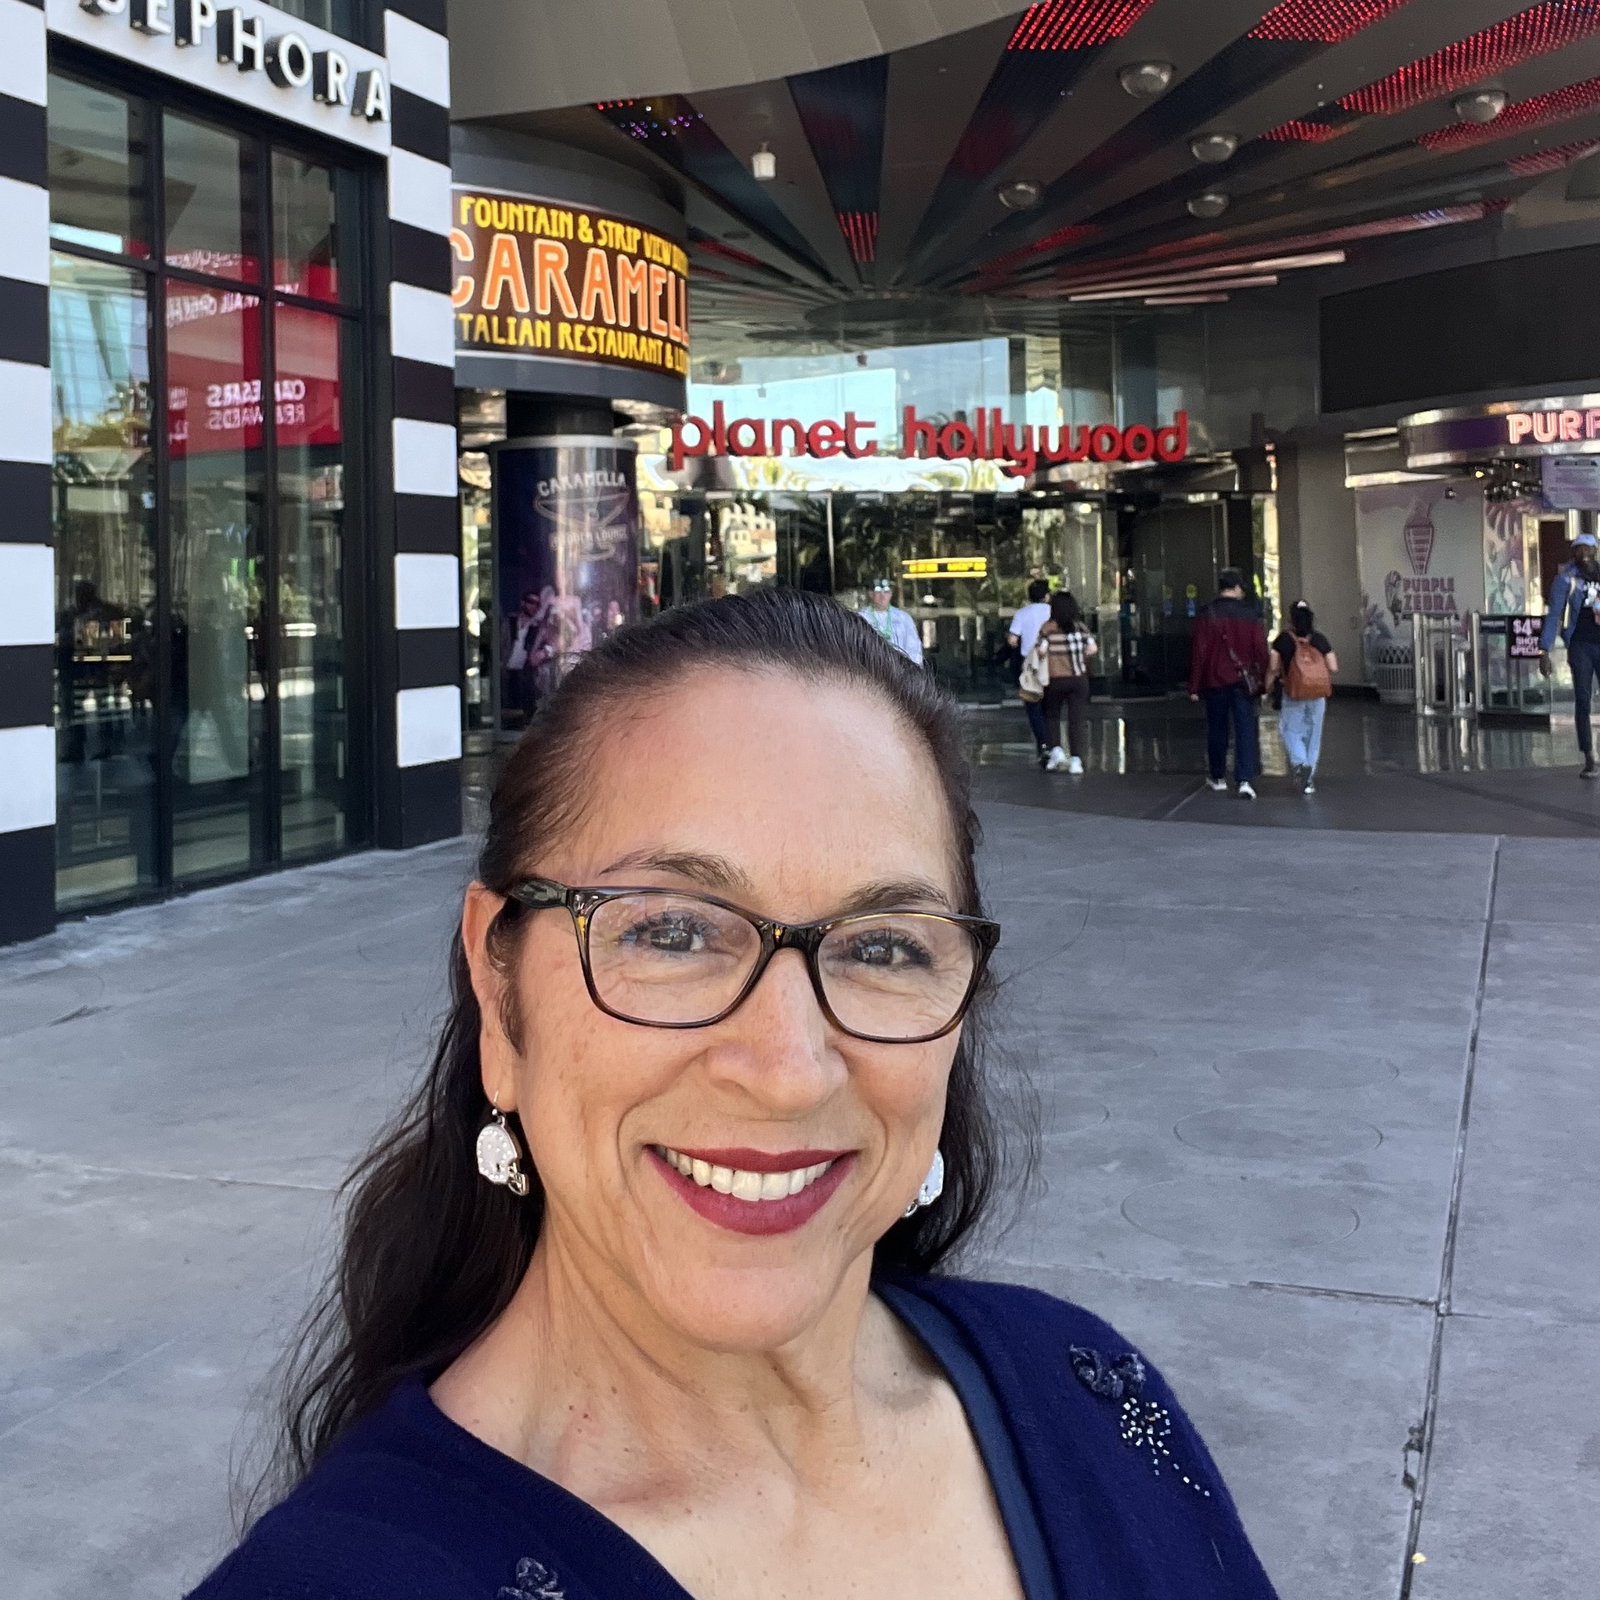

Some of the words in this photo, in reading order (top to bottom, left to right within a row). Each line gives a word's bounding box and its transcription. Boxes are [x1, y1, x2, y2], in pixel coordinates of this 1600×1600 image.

[88, 0, 390, 122] EPHORA
[460, 196, 573, 240] FOUNTAIN
[577, 214, 594, 244] &
[597, 219, 641, 254] STRIP
[643, 231, 672, 266] VIEW
[455, 313, 552, 348] TALIAN
[558, 321, 663, 366] RESTAURANT
[669, 400, 878, 471] planet
[902, 405, 1188, 477] hollywood
[537, 471, 626, 496] CARAMELLA
[1403, 577, 1455, 593] PURPLE
[1404, 594, 1457, 610] ZEBRA
